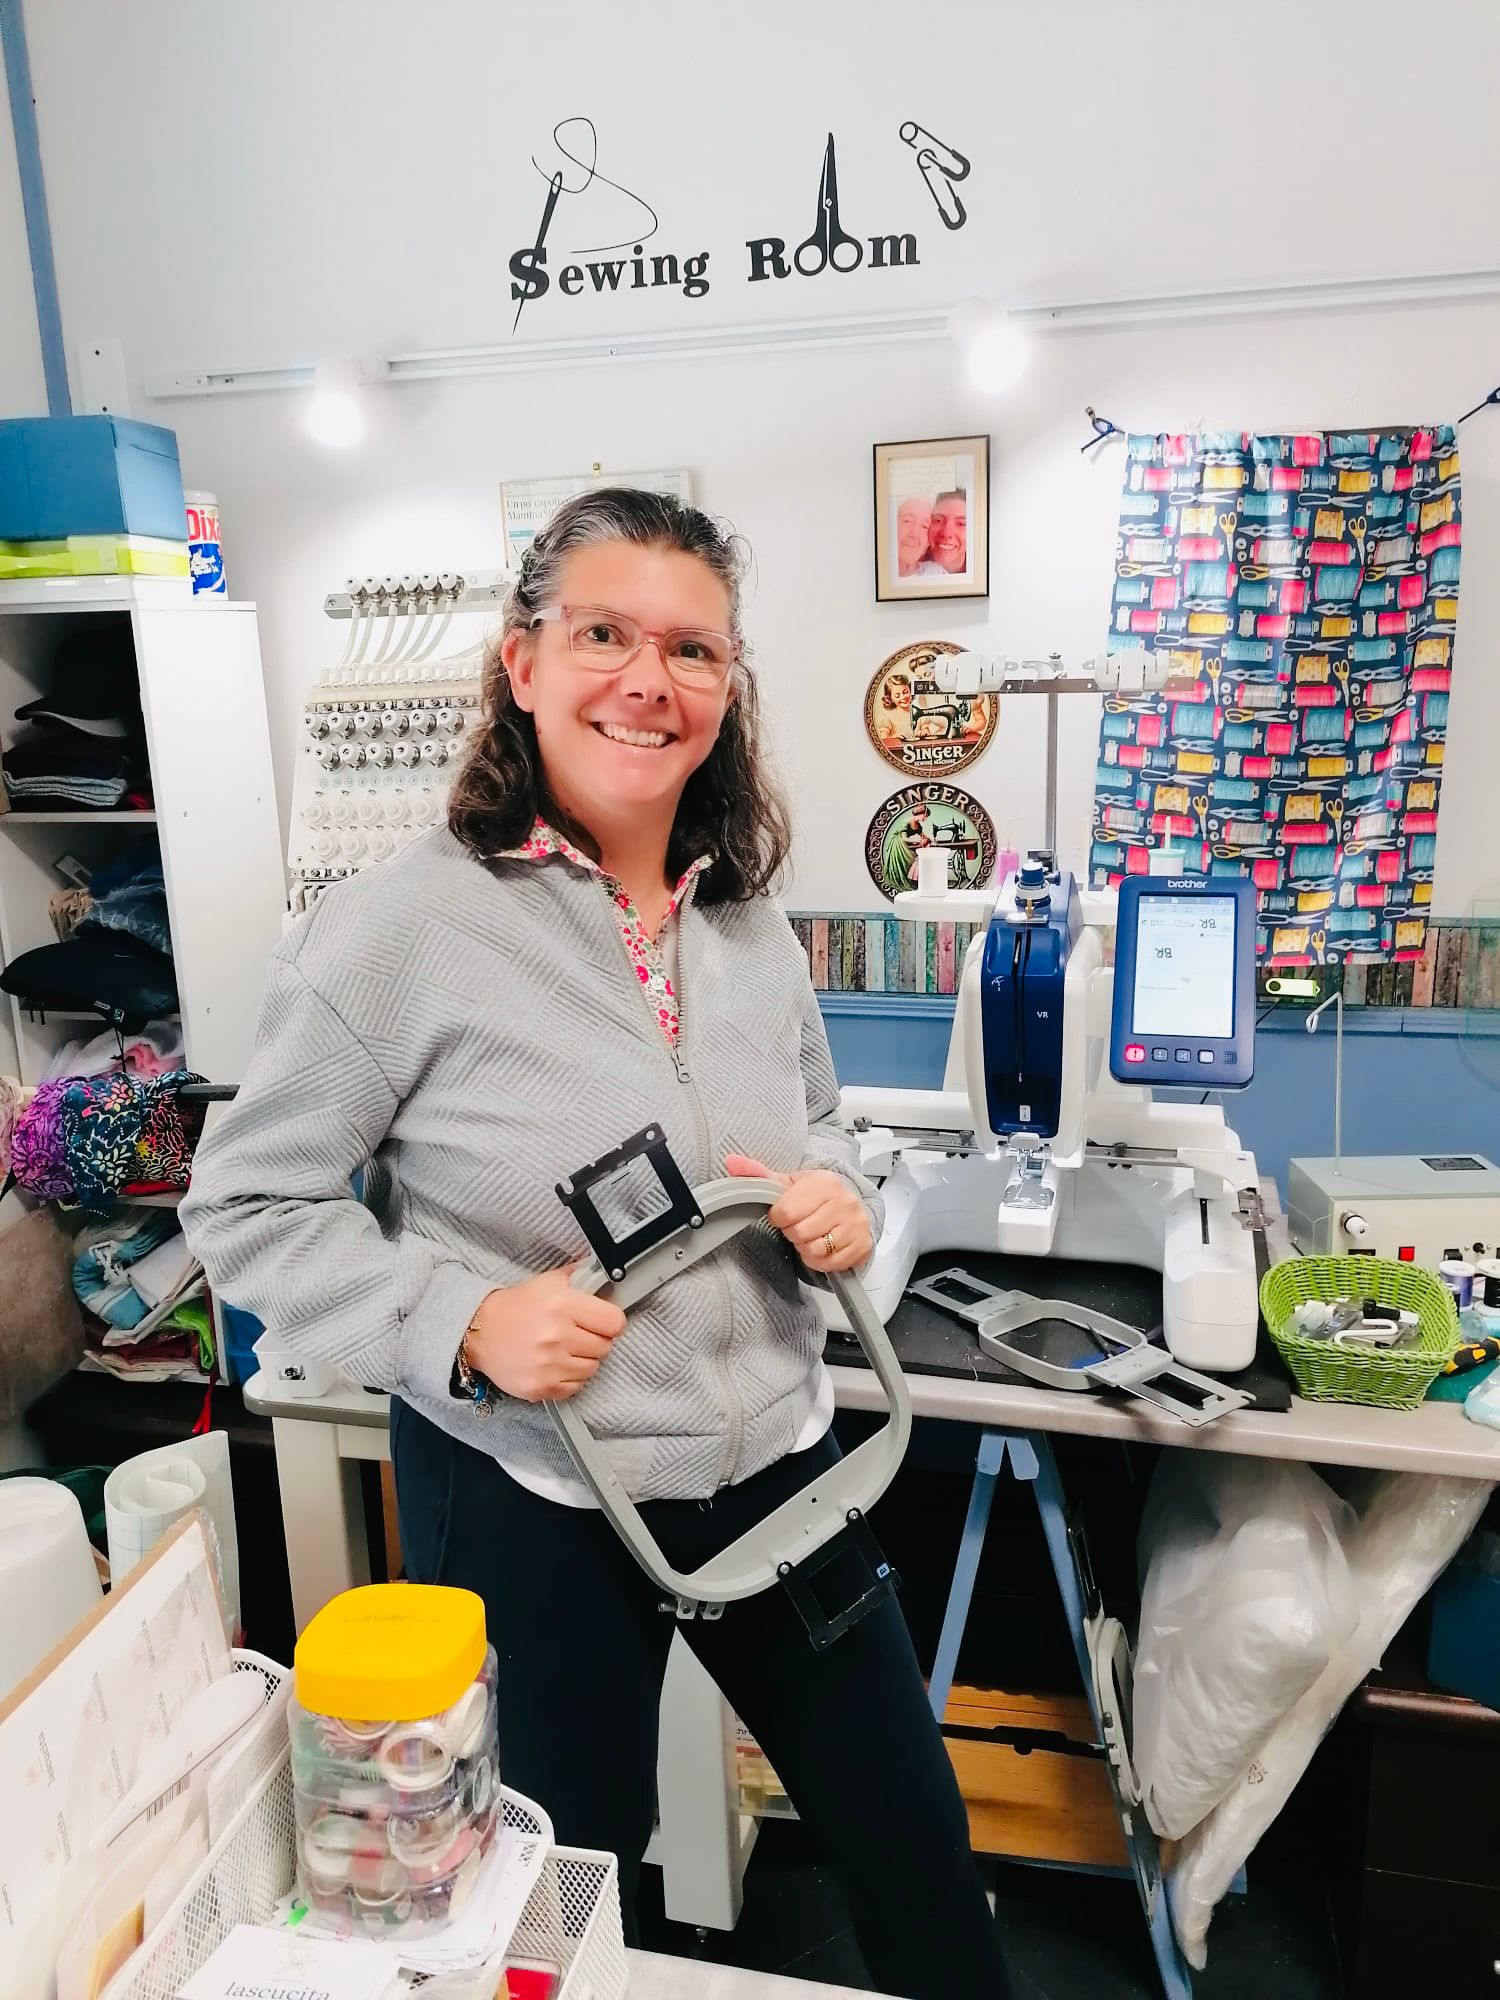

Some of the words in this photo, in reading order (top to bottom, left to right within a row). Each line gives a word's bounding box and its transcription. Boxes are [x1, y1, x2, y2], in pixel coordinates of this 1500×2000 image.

[508, 245, 711, 301] Sewing
[902, 744, 966, 764] SINGER
[886, 785, 970, 816] SINGER
[1167, 879, 1208, 889] brother
[1036, 1011, 1049, 1019] VR
